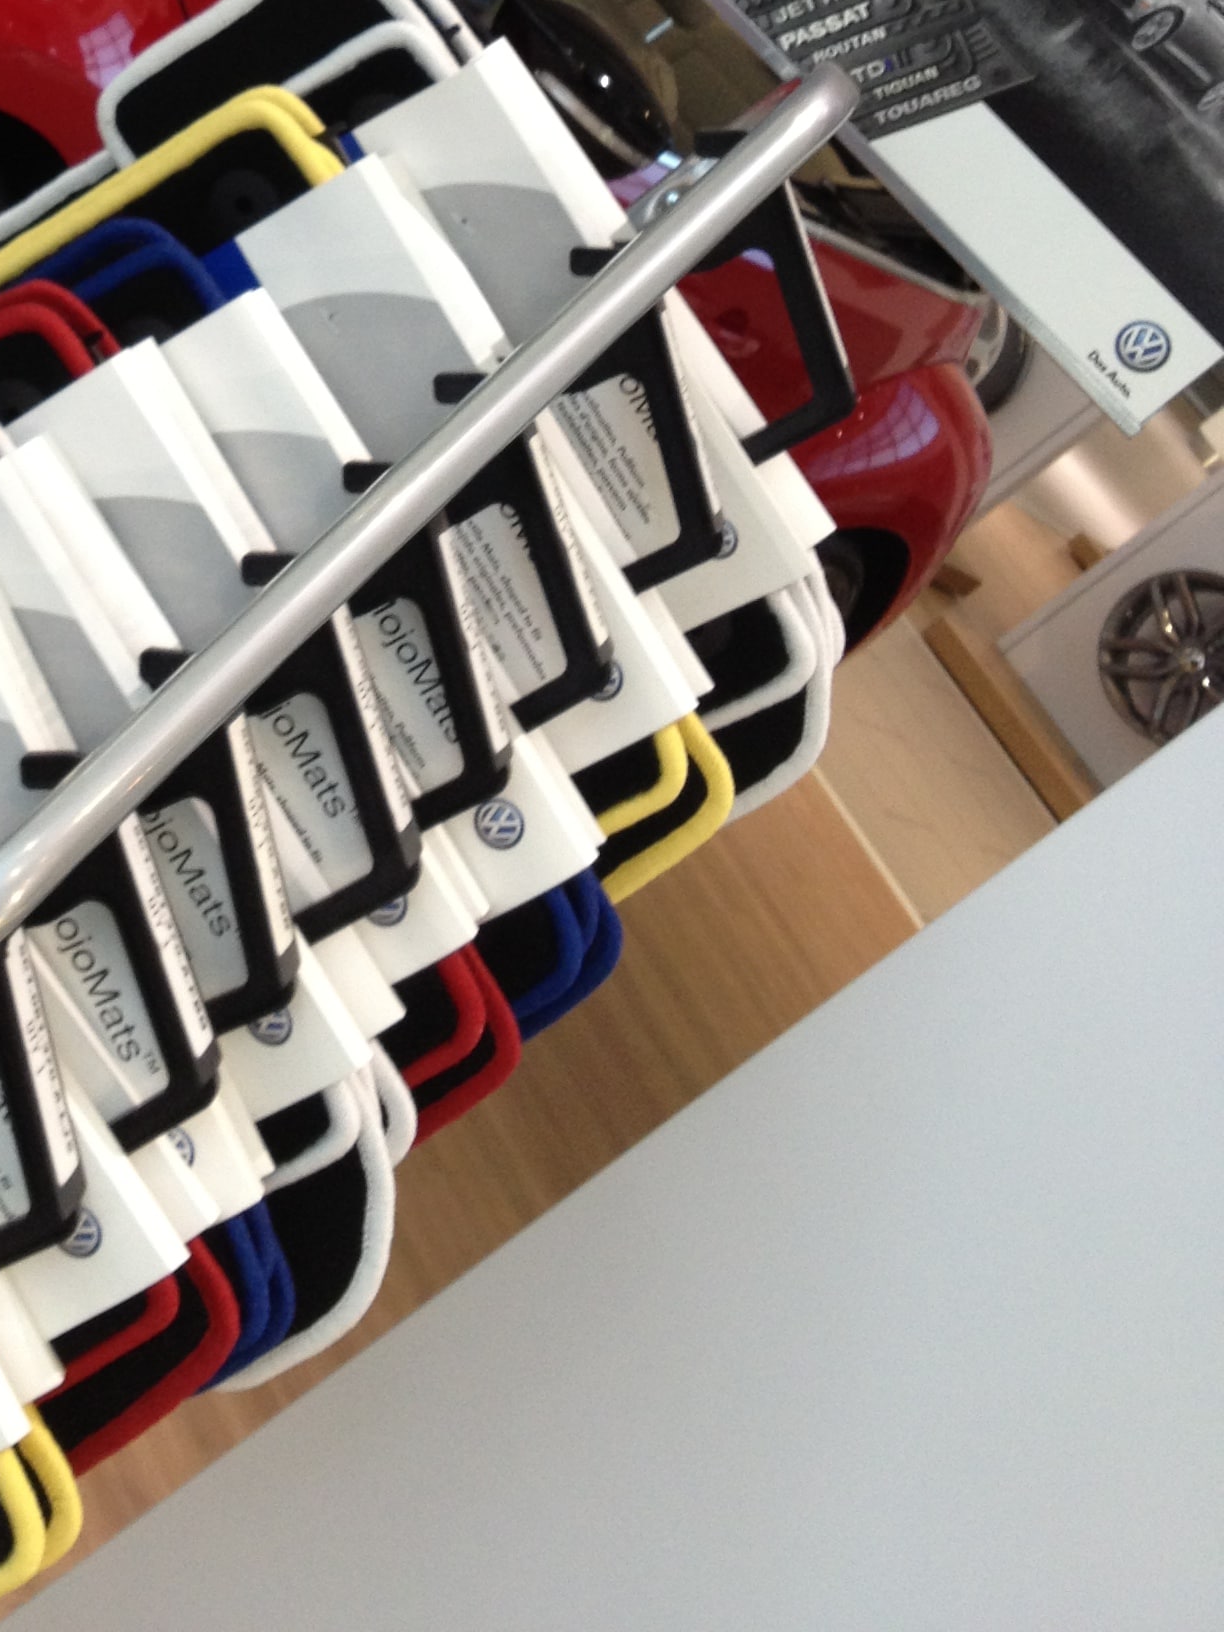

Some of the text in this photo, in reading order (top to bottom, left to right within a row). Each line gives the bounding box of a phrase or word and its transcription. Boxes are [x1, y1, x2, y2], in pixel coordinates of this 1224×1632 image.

[777, 1, 872, 52] PASSAT
[811, 26, 888, 64] ROUTAN
[872, 66, 940, 100] TIGUAN
[872, 75, 983, 124] TOUAREG
[1086, 350, 1108, 373] Das
